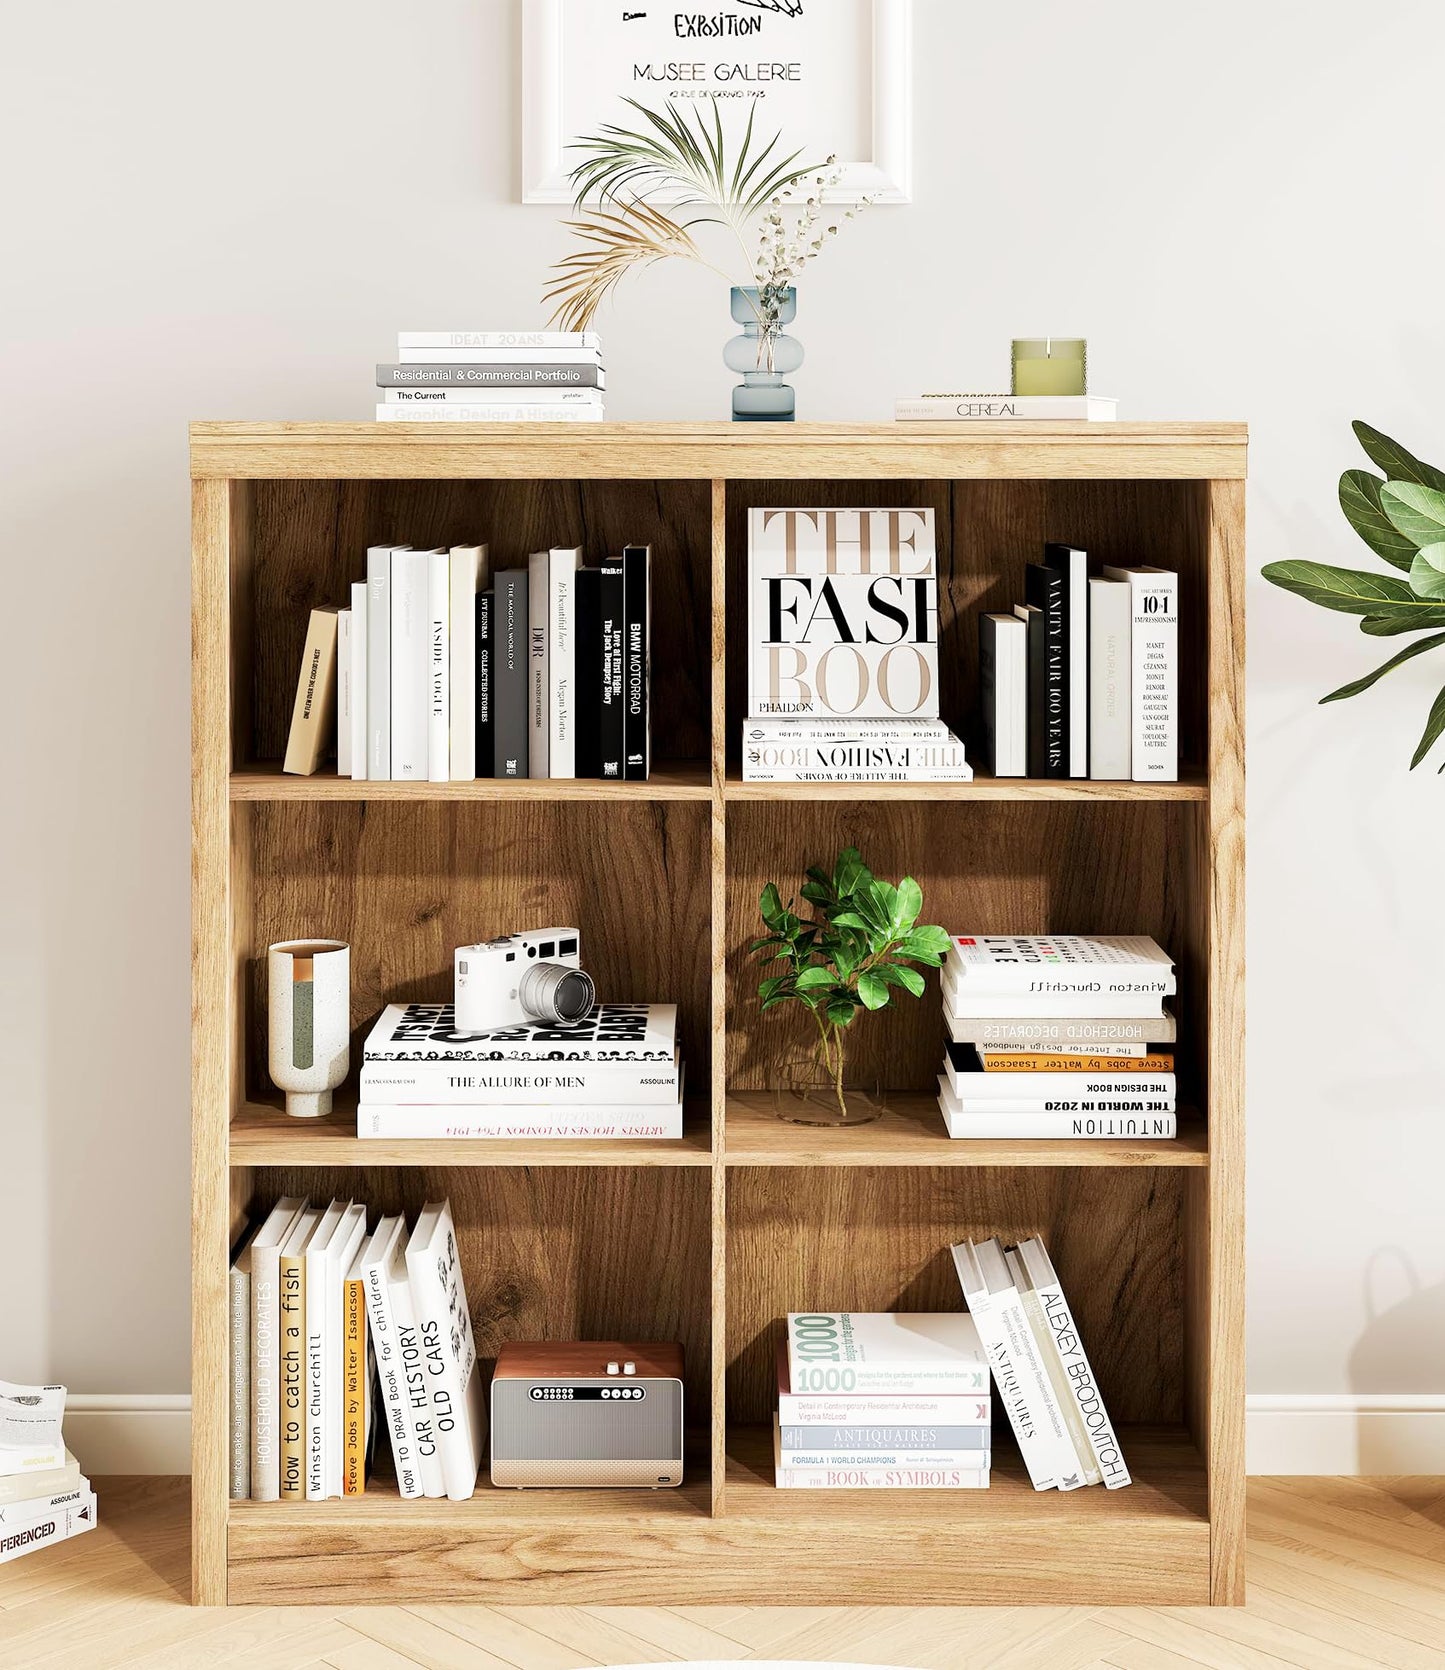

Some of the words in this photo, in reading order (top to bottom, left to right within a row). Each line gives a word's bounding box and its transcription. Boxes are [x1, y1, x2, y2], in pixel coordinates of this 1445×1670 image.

[674, 12, 762, 38] EXPOSITION
[634, 63, 706, 81] MUSEE
[714, 63, 801, 81] GALERIE
[393, 370, 452, 381] Residential
[456, 370, 465, 381] &
[467, 370, 532, 381] Commercial
[535, 370, 581, 381] Portfolio
[397, 391, 413, 400] The
[414, 391, 446, 400] Current
[957, 403, 1024, 416] CEREAL
[764, 510, 932, 576] THE
[558, 594, 567, 630] beautiful
[1050, 579, 1061, 636] VANITY
[604, 620, 612, 633] The
[433, 621, 443, 665] INSIDE
[532, 628, 544, 657] DIOR
[604, 634, 612, 650] Jack
[613, 630, 622, 647] Love
[630, 623, 641, 652] BMW
[508, 660, 515, 669] OF
[604, 653, 612, 685] Dempsey
[613, 658, 622, 674] First
[1050, 645, 1061, 681] FAIR
[612, 676, 622, 696] Fight:
[630, 654, 641, 715] MOTORRAD
[762, 645, 931, 714] BOO
[433, 672, 443, 717] VOGUE
[557, 680, 567, 708] Megan
[604, 686, 612, 705] Story
[759, 702, 814, 713] PHAIDON
[557, 710, 567, 741] Morton
[1050, 718, 1061, 767] YEARS
[817, 748, 909, 767] FASHION
[400, 1005, 443, 1023] NOT
[597, 1004, 650, 1041] BABY!
[390, 1024, 433, 1041] IT'S
[983, 1042, 1026, 1050] Handbook
[1030, 1043, 1063, 1052] Design
[1070, 1045, 1110, 1053] Interior
[987, 1061, 1037, 1069] Isaacson
[1044, 1061, 1082, 1069] Walter
[1088, 1059, 1101, 1069] by
[1107, 1061, 1132, 1069] Jobs
[1138, 1061, 1169, 1069] Steve
[447, 1076, 476, 1088] THE
[478, 1076, 531, 1088] ALLURE
[534, 1076, 553, 1088] OF
[555, 1076, 585, 1088] MEN
[1087, 1084, 1113, 1092] BOOK
[1114, 1084, 1149, 1092] DESIGN
[1150, 1084, 1168, 1092] THE
[1045, 1102, 1078, 1110] 2020
[1082, 1102, 1094, 1110] IN
[1098, 1102, 1144, 1110] WORLD
[1147, 1102, 1170, 1110] THE
[505, 1126, 553, 1135] LONDON
[556, 1126, 568, 1135] IN
[572, 1126, 615, 1135] HOUSES
[1073, 1119, 1170, 1135] INTUITION
[233, 1279, 242, 1307] house
[282, 1268, 299, 1313] fish
[369, 1269, 388, 1332] children
[234, 1313, 242, 1329] the
[349, 1283, 357, 1340] Isaacson
[257, 1282, 271, 1368] DECORATES
[287, 1327, 299, 1337] a
[234, 1334, 242, 1345] in
[422, 1320, 445, 1376] CARS
[794, 1316, 840, 1363] 1000
[382, 1341, 392, 1362] for
[310, 1334, 321, 1416] Churchill
[348, 1350, 357, 1394] Walter
[399, 1326, 428, 1408] HISTORY
[234, 1351, 245, 1410] arrangement
[284, 1351, 299, 1408] catch
[388, 1371, 399, 1400] Book
[798, 1368, 857, 1392] 1000
[1041, 1294, 1081, 1357] ALEXEY
[1068, 1362, 1124, 1477] BRODOVITCH
[992, 1343, 1037, 1438] ANTIQUAIRES
[348, 1400, 359, 1414] by
[434, 1391, 455, 1432] OLD
[824, 1402, 866, 1411] Contemporary
[236, 1416, 242, 1427] an
[257, 1378, 271, 1466] HOUSEHOLD
[395, 1409, 406, 1439] DRAW
[284, 1422, 299, 1443] to
[348, 1421, 357, 1449] Jobs
[413, 1420, 436, 1456] CAR
[834, 1429, 937, 1444] ANTIQUAIRES
[233, 1432, 242, 1455] make
[310, 1426, 321, 1492] Winston
[401, 1447, 409, 1464] TO
[284, 1457, 299, 1492] How
[348, 1457, 357, 1492] Steve
[404, 1470, 414, 1494] HOW
[827, 1471, 869, 1486] BOOK
[886, 1471, 960, 1486] SYMBOLS
[50, 1492, 81, 1506] ASSOULINE
